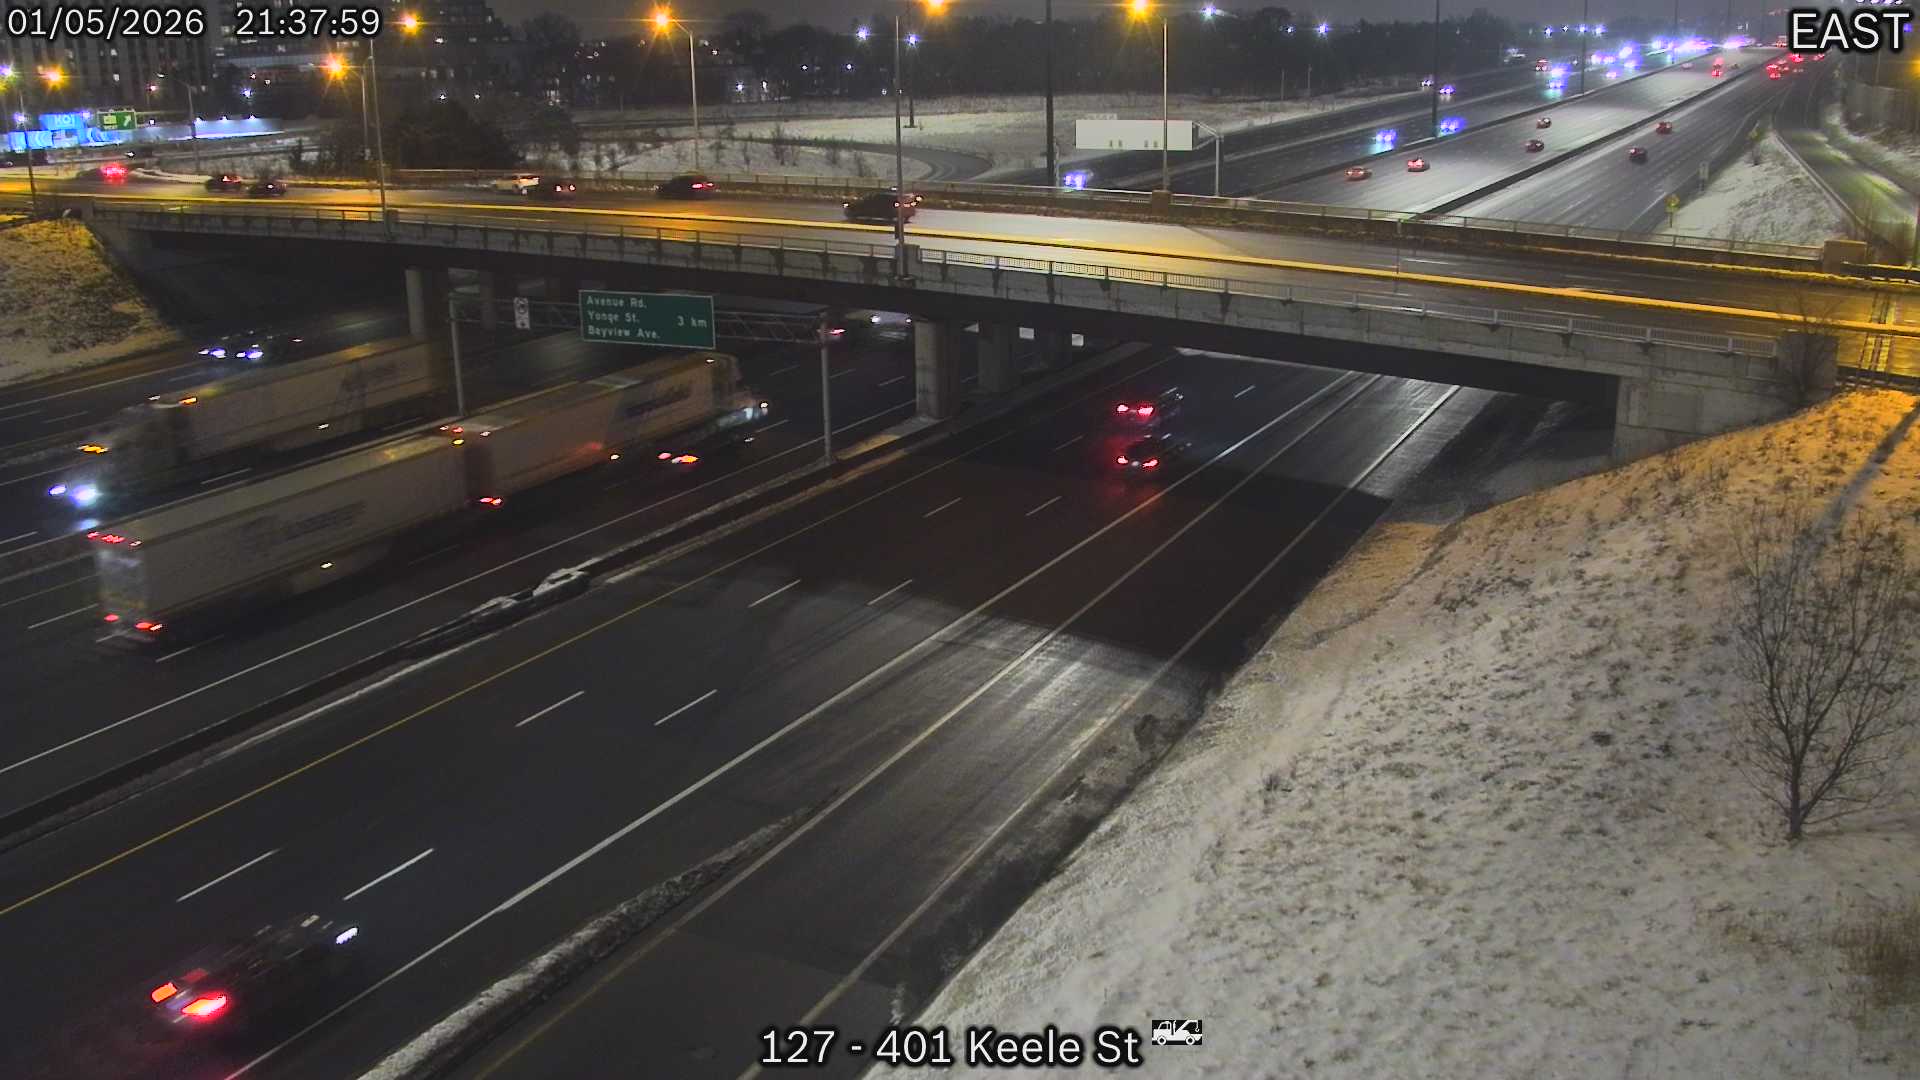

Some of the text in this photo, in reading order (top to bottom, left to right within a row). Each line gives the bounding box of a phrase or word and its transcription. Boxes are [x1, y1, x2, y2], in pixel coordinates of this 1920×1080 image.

[587, 296, 648, 308] Avenue Rd.
[588, 311, 640, 323] Yonge St.
[677, 316, 707, 328] 3 km
[588, 325, 660, 339] Bayview Ave.
